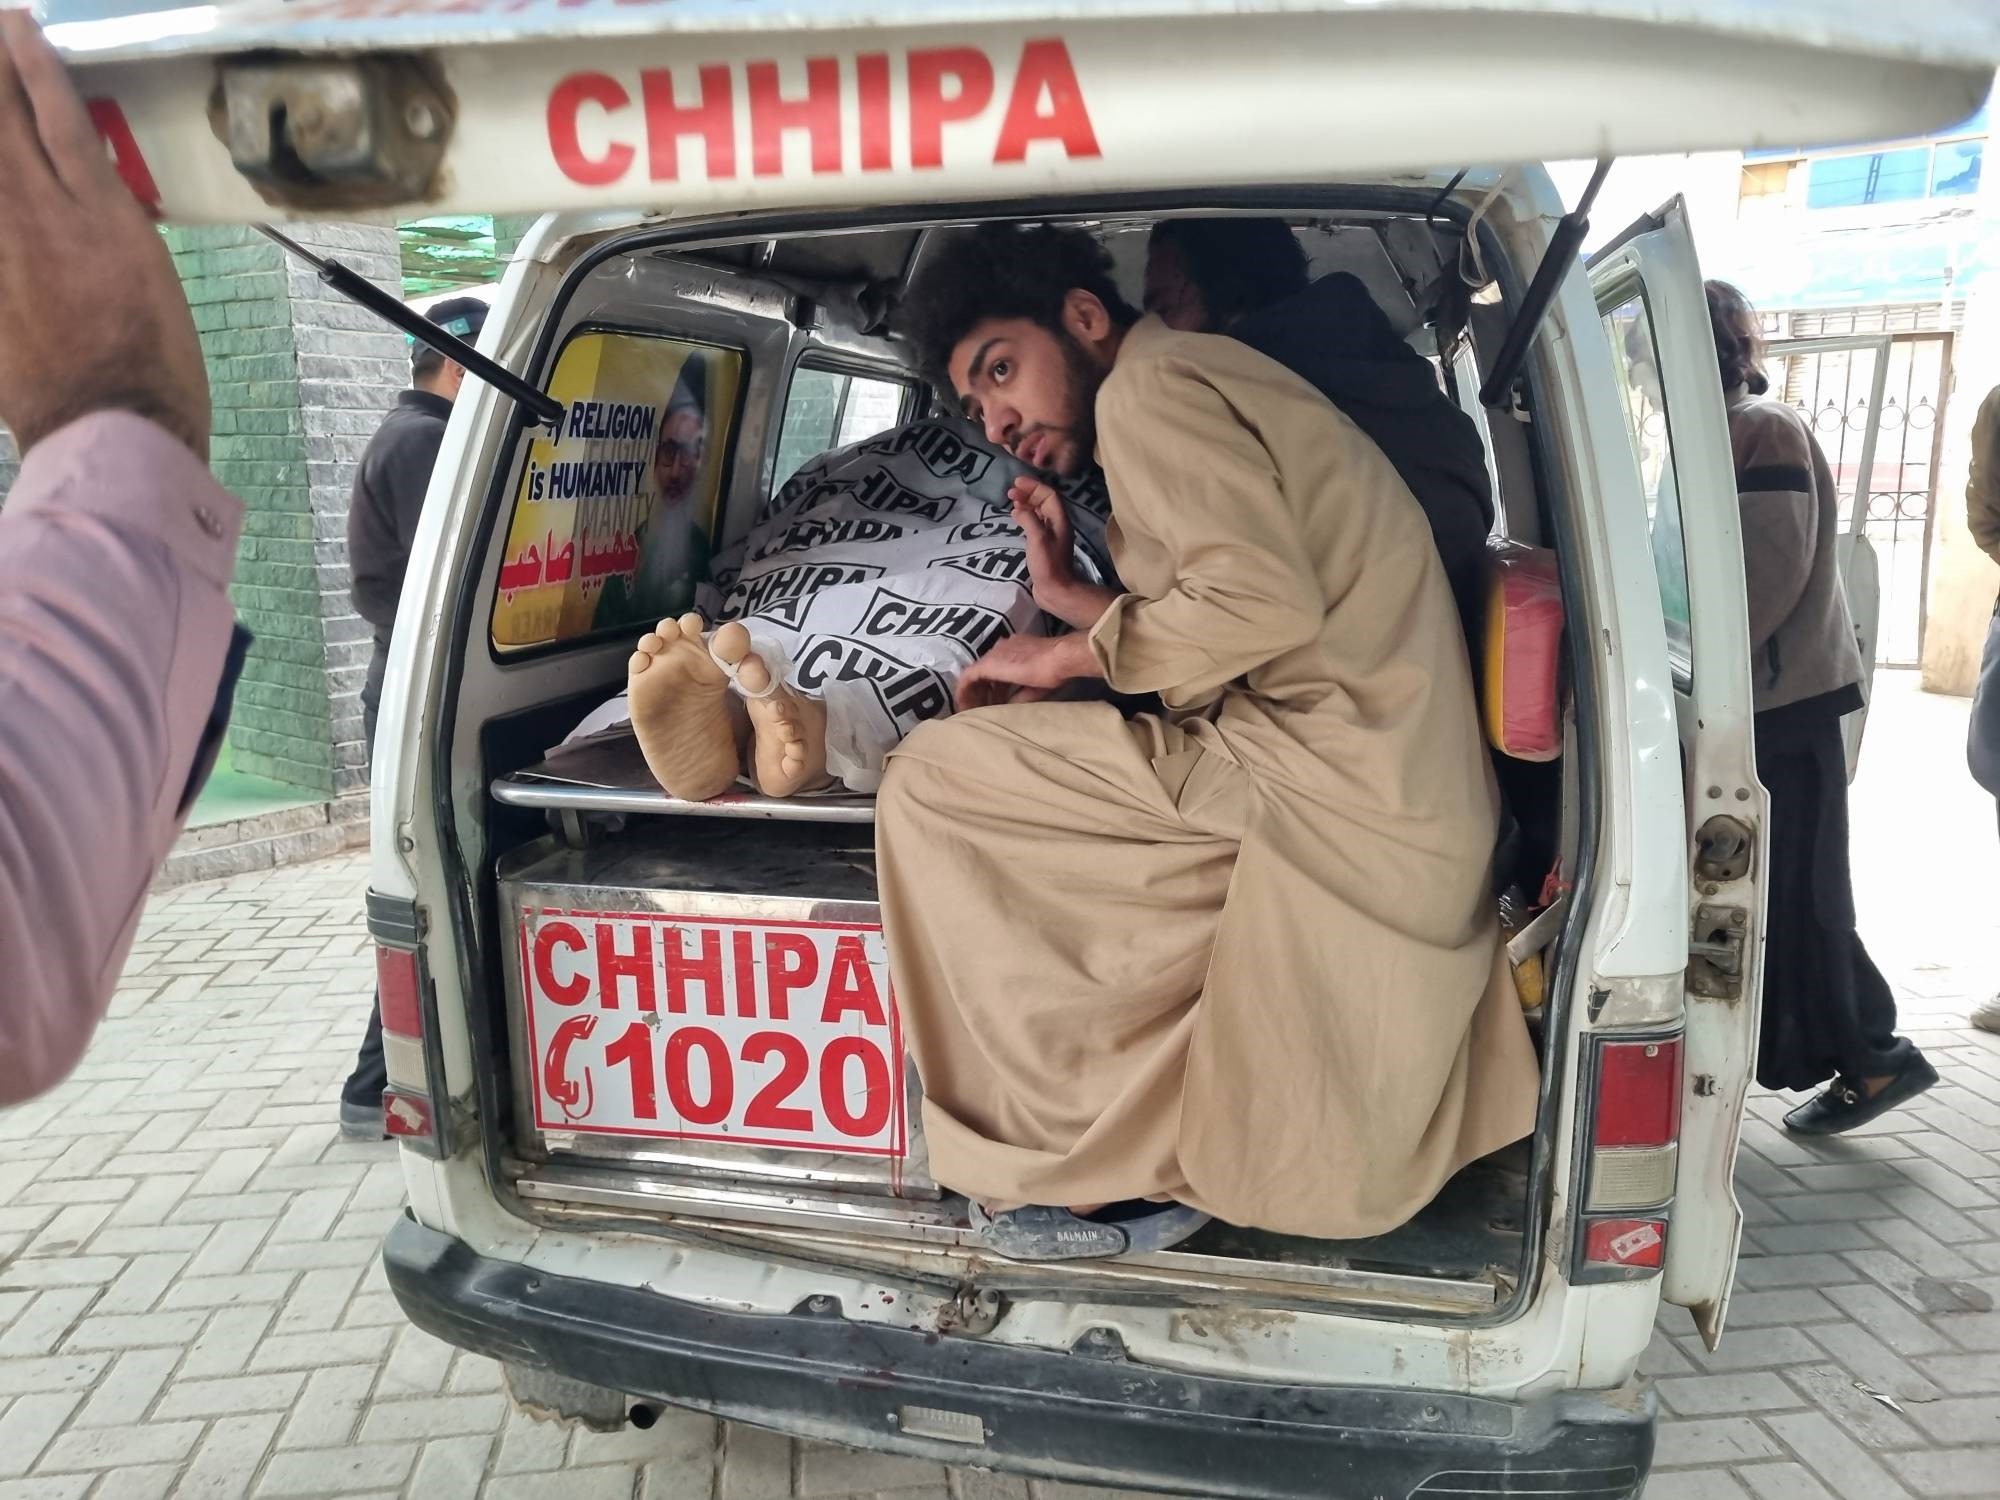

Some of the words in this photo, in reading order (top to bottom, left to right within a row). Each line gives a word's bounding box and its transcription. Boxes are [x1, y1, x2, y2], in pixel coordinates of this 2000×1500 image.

[546, 36, 1103, 187] CHHIPA
[568, 402, 656, 440] RELIGION
[527, 462, 545, 501] is
[548, 462, 646, 499] HUMANITY
[499, 527, 576, 603] صاحب
[534, 922, 888, 1027] CHHIPA
[605, 1022, 891, 1138] 1020
[1056, 1230, 1098, 1243] BALMAIN
